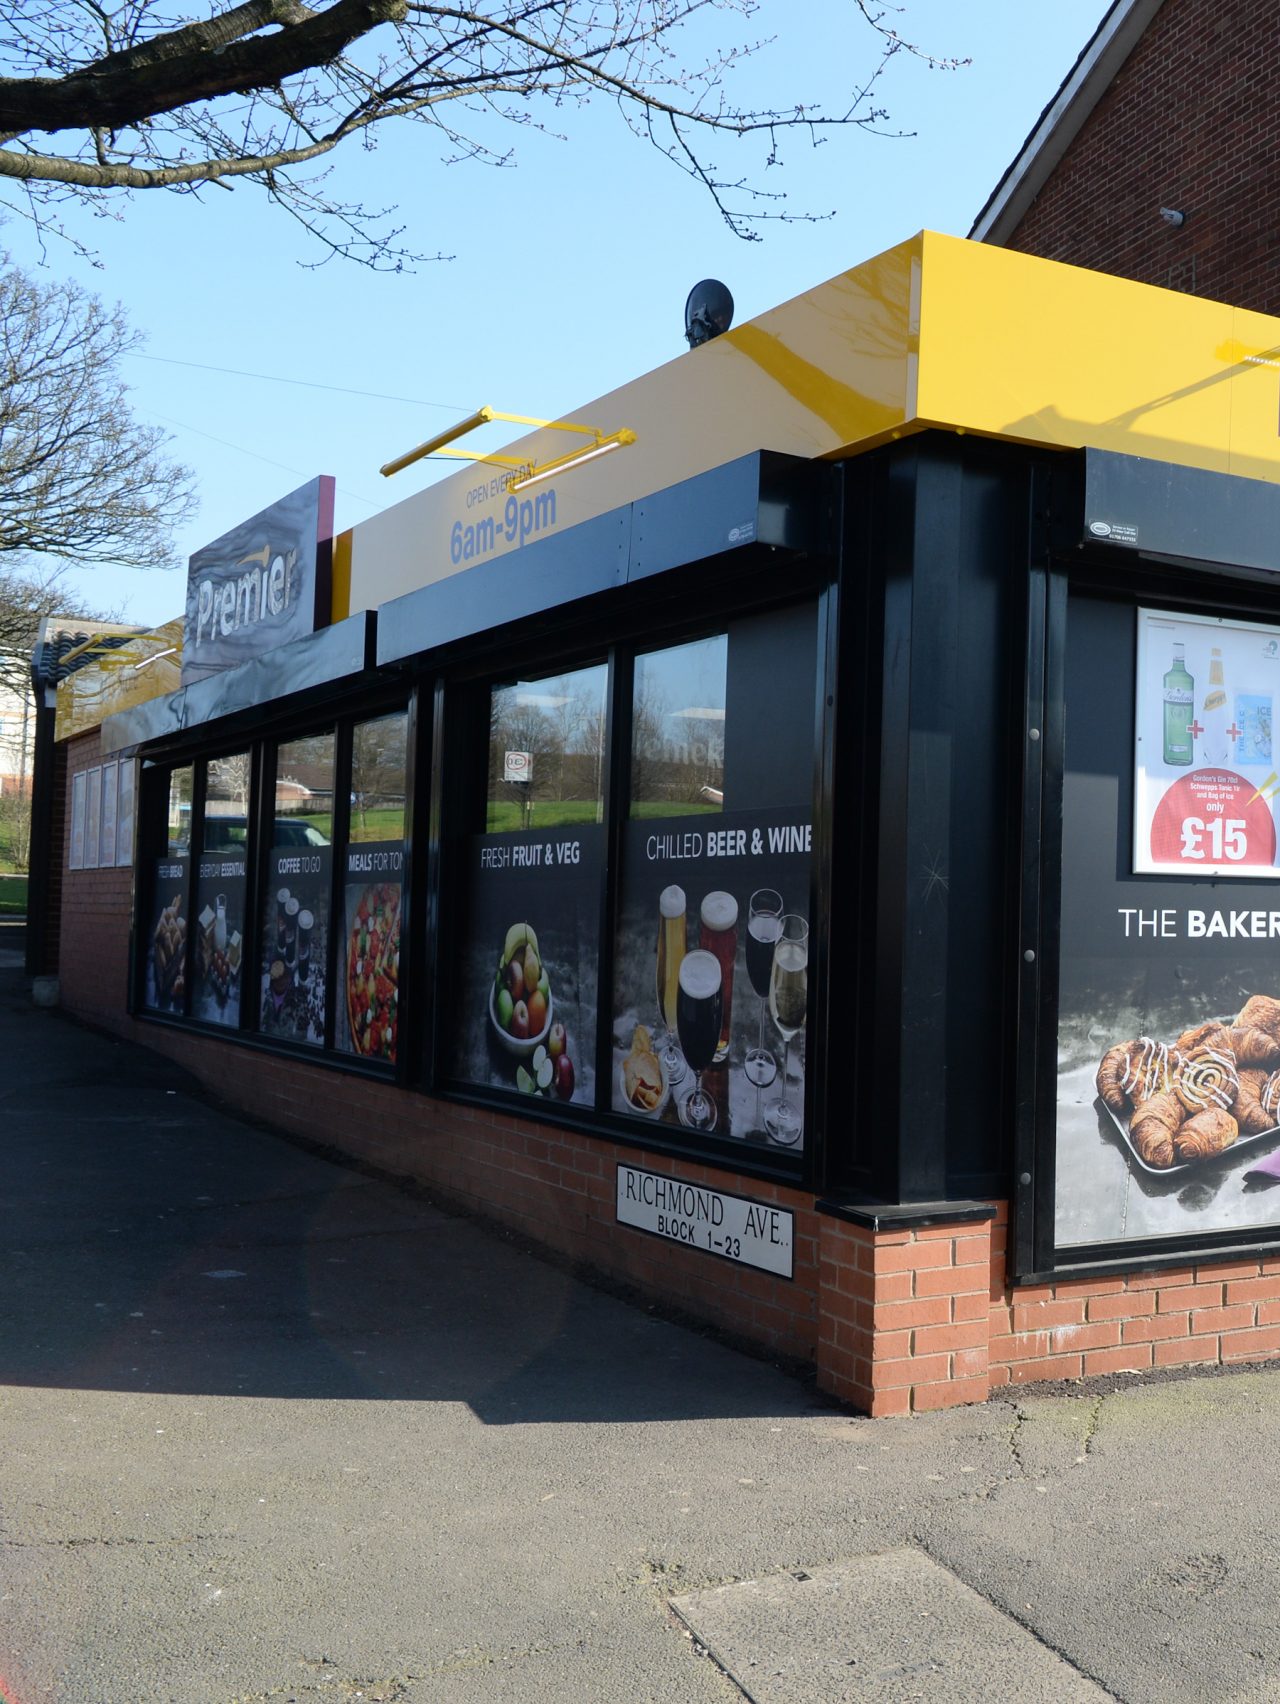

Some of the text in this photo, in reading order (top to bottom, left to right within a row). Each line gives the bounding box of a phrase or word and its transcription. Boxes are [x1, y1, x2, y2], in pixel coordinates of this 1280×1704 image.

[466, 484, 489, 509] OPEN
[450, 488, 557, 565] 6am-9pm
[195, 545, 297, 649] Premier
[1192, 775, 1217, 783] Gordon's
[1206, 802, 1225, 814] only
[646, 824, 812, 861] CHILLED BEER & WINE
[1180, 816, 1248, 861] £15
[277, 856, 321, 874] COFFEE TO GO
[348, 854, 373, 872] MEALS
[373, 853, 389, 871] FOR
[480, 841, 580, 869] FRESH FRUIT & VEG
[1118, 908, 1177, 937] THE
[626, 1170, 724, 1227] RICHMOND
[657, 1214, 742, 1258] BLOCK 1-23
